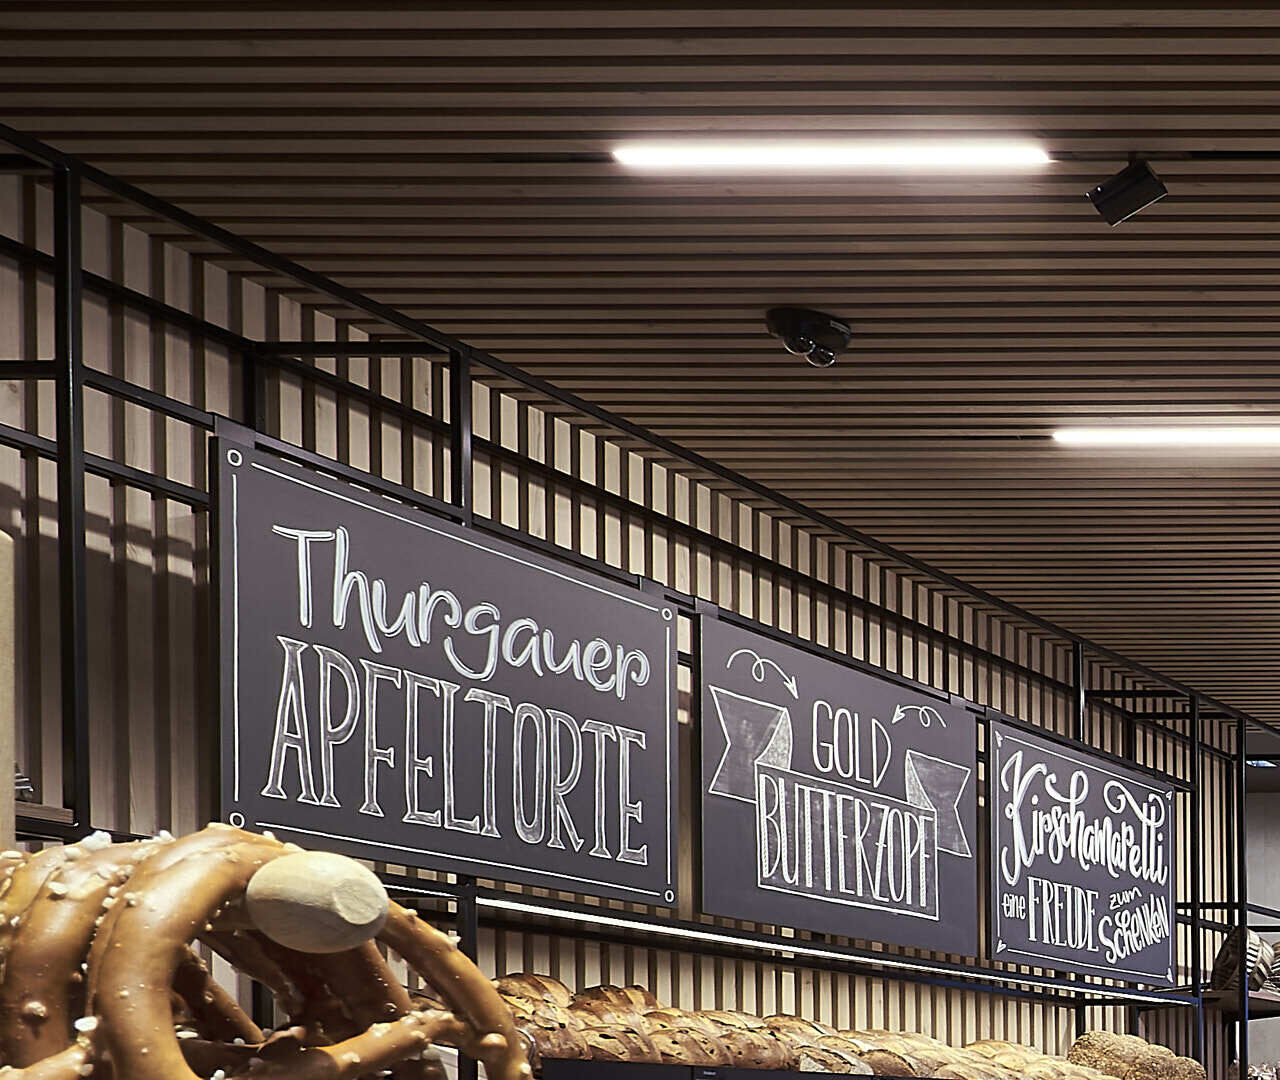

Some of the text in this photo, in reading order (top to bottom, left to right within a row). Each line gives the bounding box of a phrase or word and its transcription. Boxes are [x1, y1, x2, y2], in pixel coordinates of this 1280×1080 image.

[272, 526, 650, 699] Thurgauer
[262, 636, 648, 865] APFELTORTE
[813, 700, 891, 788] GOLD
[760, 774, 933, 907] BUTTERZOPF
[1002, 876, 1142, 952] eine FREUDE zum
